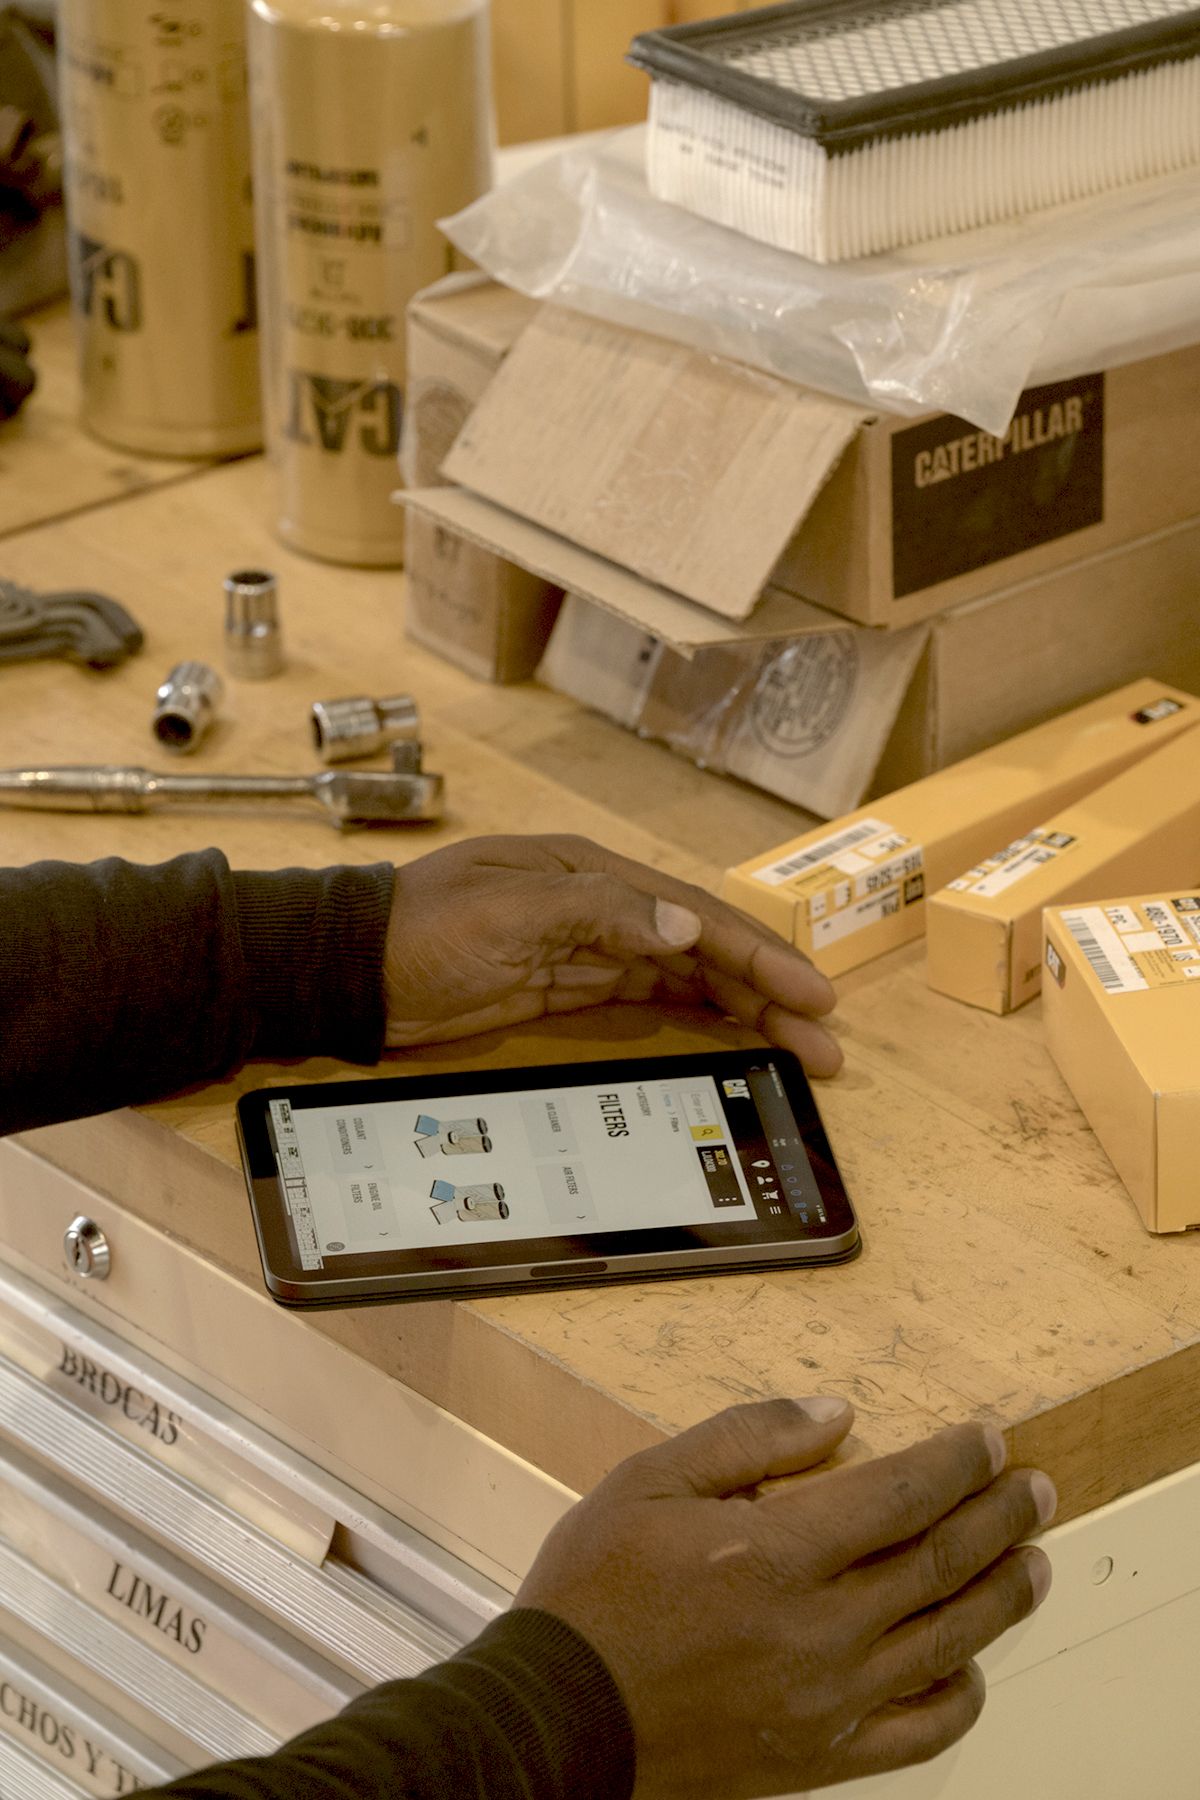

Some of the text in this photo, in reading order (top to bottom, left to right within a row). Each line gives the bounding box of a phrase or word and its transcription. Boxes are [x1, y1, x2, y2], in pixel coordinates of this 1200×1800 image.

[286, 371, 403, 457] CAT
[914, 396, 1083, 489] CATERPILLAR
[722, 1078, 750, 1100] CAT
[352, 1117, 366, 1140] COOLANT
[545, 1102, 561, 1132] AIR CLEANER
[598, 1094, 629, 1137] FILTERS
[335, 1119, 352, 1154] CONDITIONERS
[350, 1184, 363, 1202] FILTERS
[367, 1182, 382, 1210] ENGINE OIL
[563, 1166, 578, 1194] AIR FILTERS
[57, 1343, 183, 1446] BROCAS
[106, 1562, 207, 1654] LIMAS
[0, 1682, 75, 1758] CHOS
[84, 1739, 104, 1778] Y
